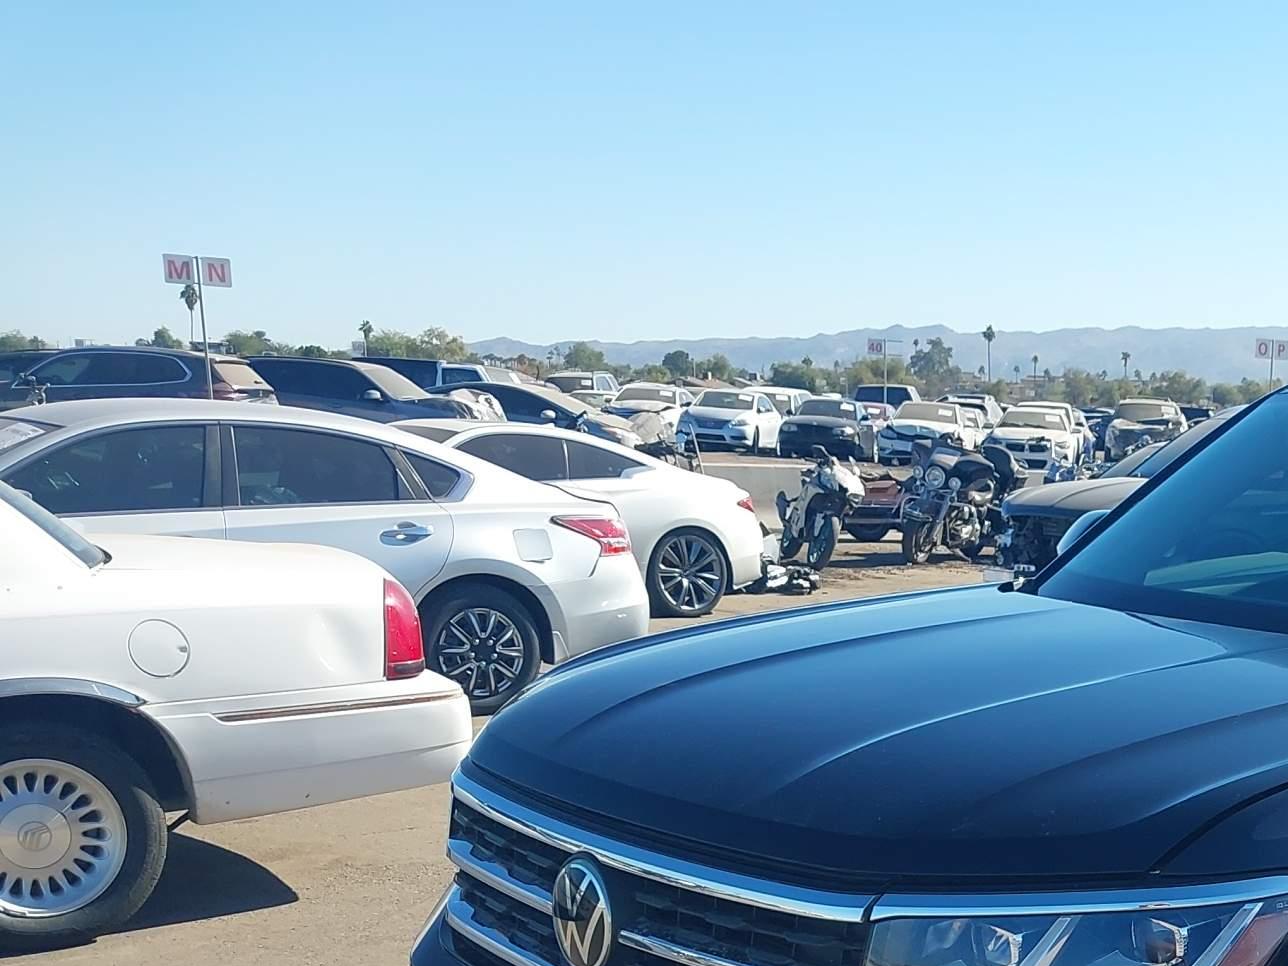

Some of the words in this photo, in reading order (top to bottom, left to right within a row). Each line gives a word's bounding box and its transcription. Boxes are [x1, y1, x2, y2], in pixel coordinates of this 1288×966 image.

[167, 260, 191, 280] M
[207, 262, 226, 282] N
[1278, 343, 1285, 357] P
